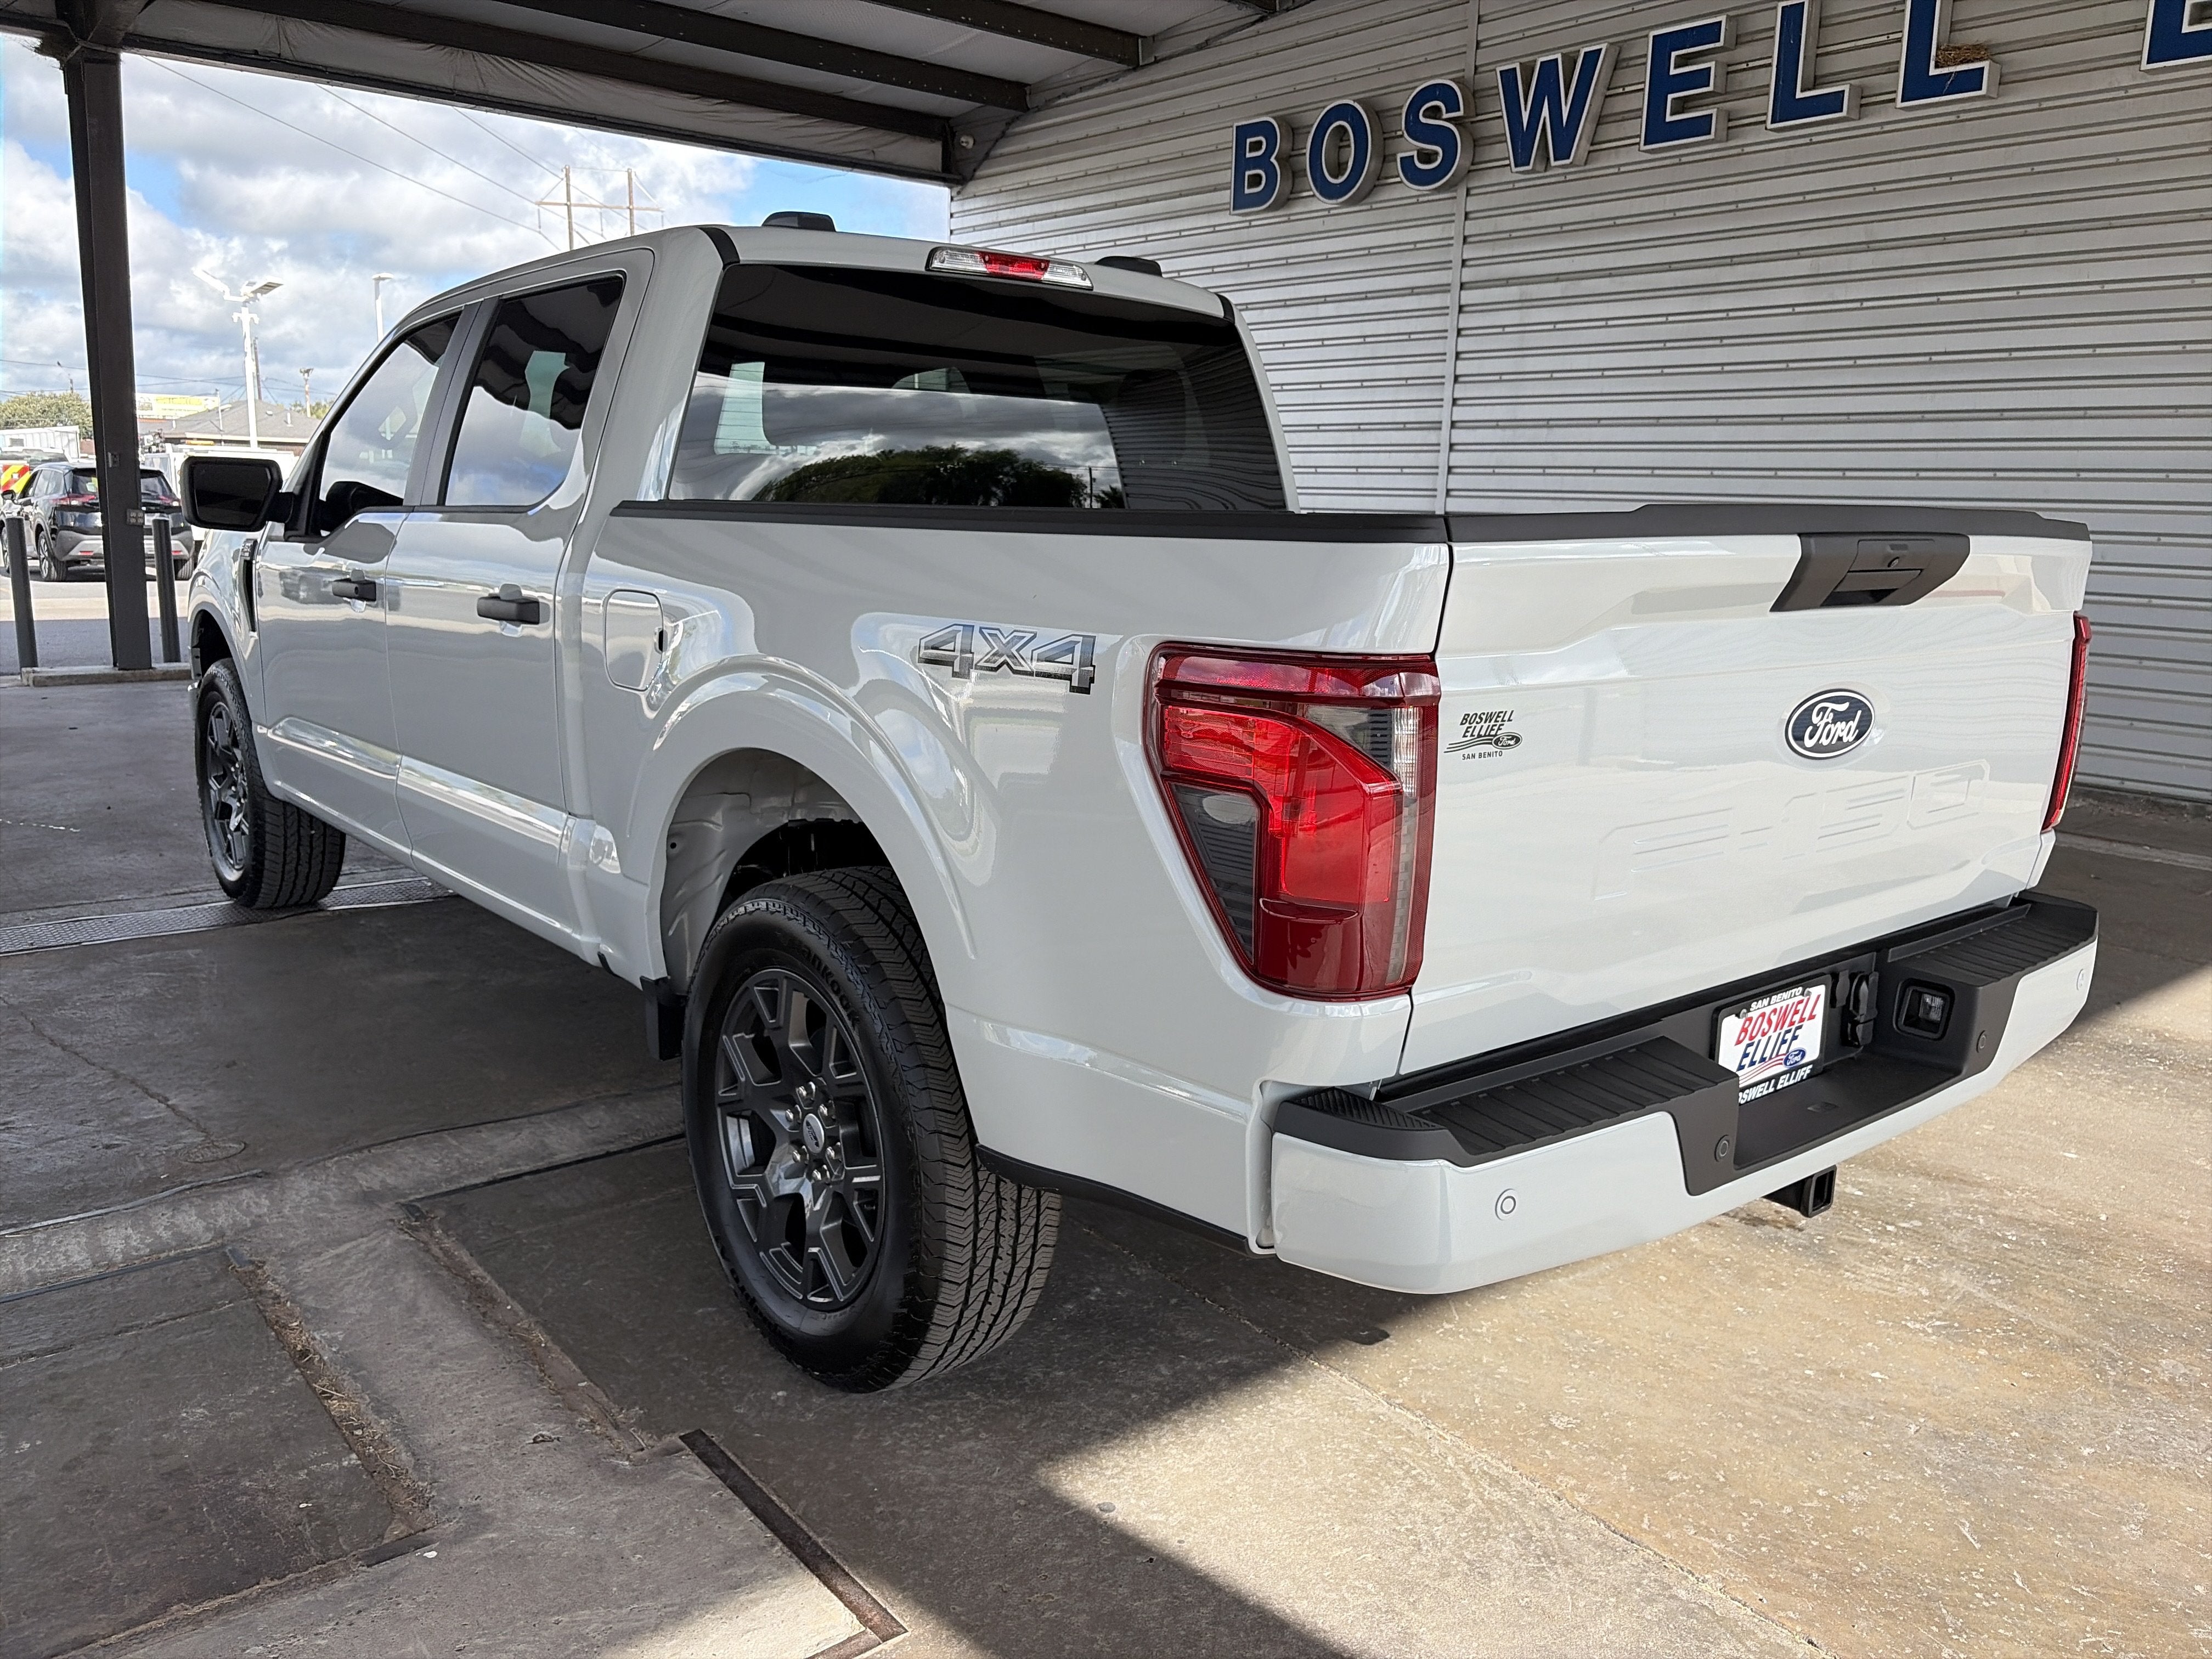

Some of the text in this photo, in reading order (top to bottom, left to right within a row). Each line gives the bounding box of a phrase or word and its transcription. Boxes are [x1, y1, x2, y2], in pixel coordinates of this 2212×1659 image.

[1231, 0, 1990, 215] BOSWELL
[1459, 710, 1514, 725] BOSWELL
[1462, 724, 1504, 738] ELLIFF
[1804, 702, 1862, 748] Ford
[1498, 736, 1516, 746] Ford
[1594, 759, 1991, 901] F-150
[1750, 987, 1803, 1012] SAN BENITO
[1734, 994, 1821, 1046] BOSWELL
[1736, 1024, 1803, 1071] ELLIFF
[1786, 1050, 1803, 1066] Ford
[1739, 1065, 1813, 1104] SWELL ELLIFF
